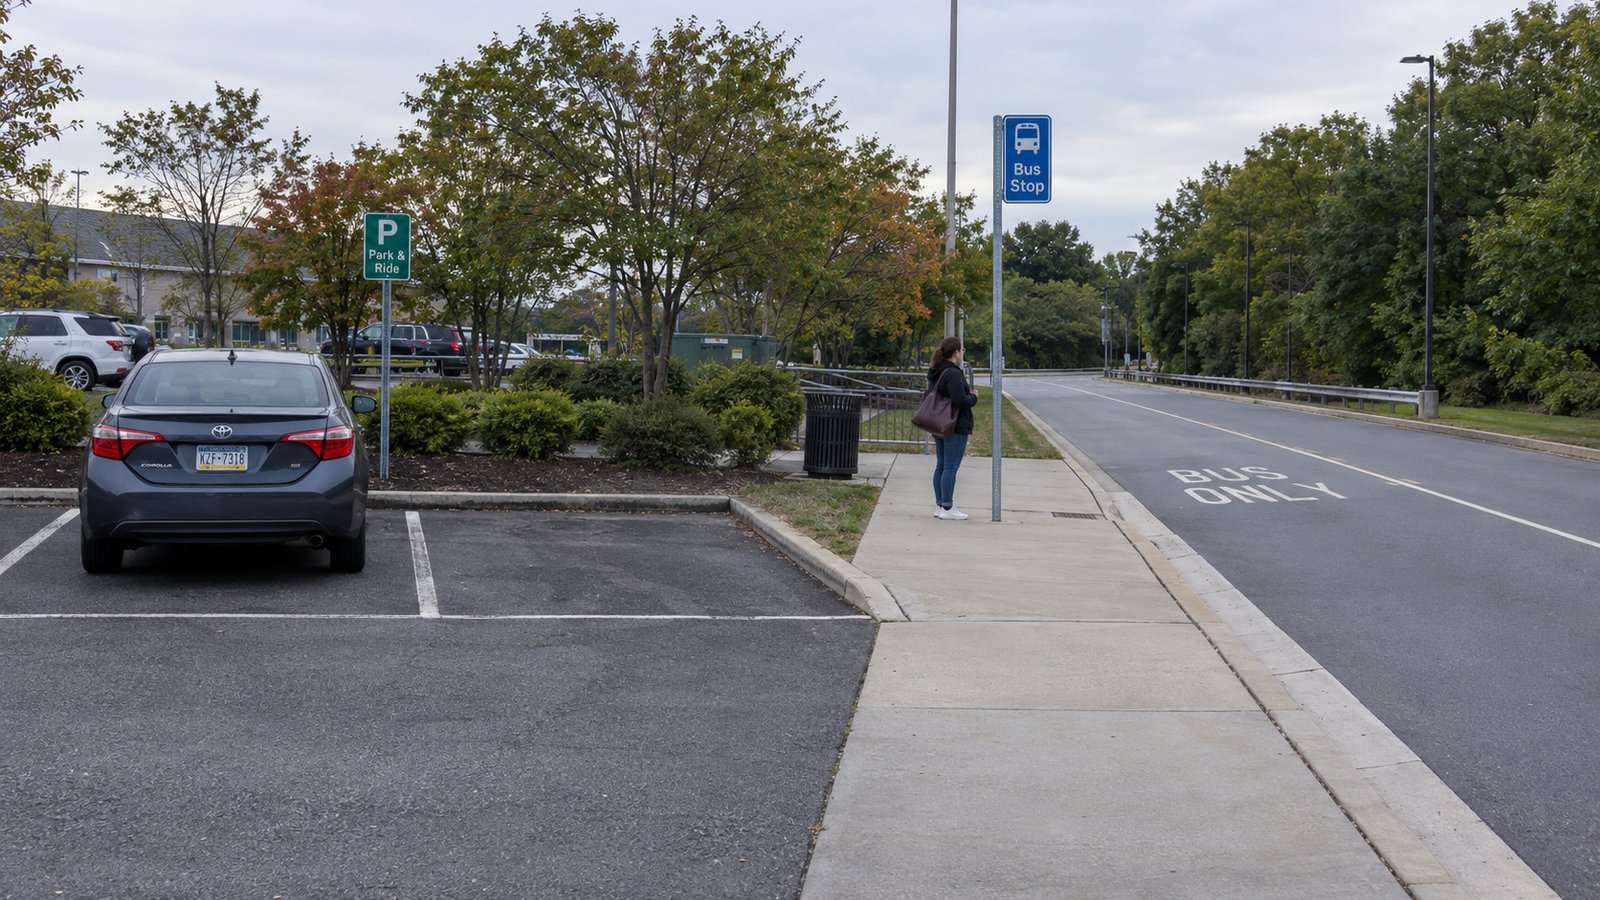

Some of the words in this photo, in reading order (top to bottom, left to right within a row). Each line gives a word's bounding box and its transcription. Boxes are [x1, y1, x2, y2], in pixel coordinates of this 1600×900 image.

[1013, 163, 1041, 176] Bus
[1010, 179, 1045, 195] Stop
[378, 219, 398, 245] P
[368, 250, 394, 260] Park
[397, 250, 406, 260] &
[375, 263, 400, 274] Ride
[1166, 466, 1289, 484] BUS
[1184, 482, 1348, 504] ONLY
